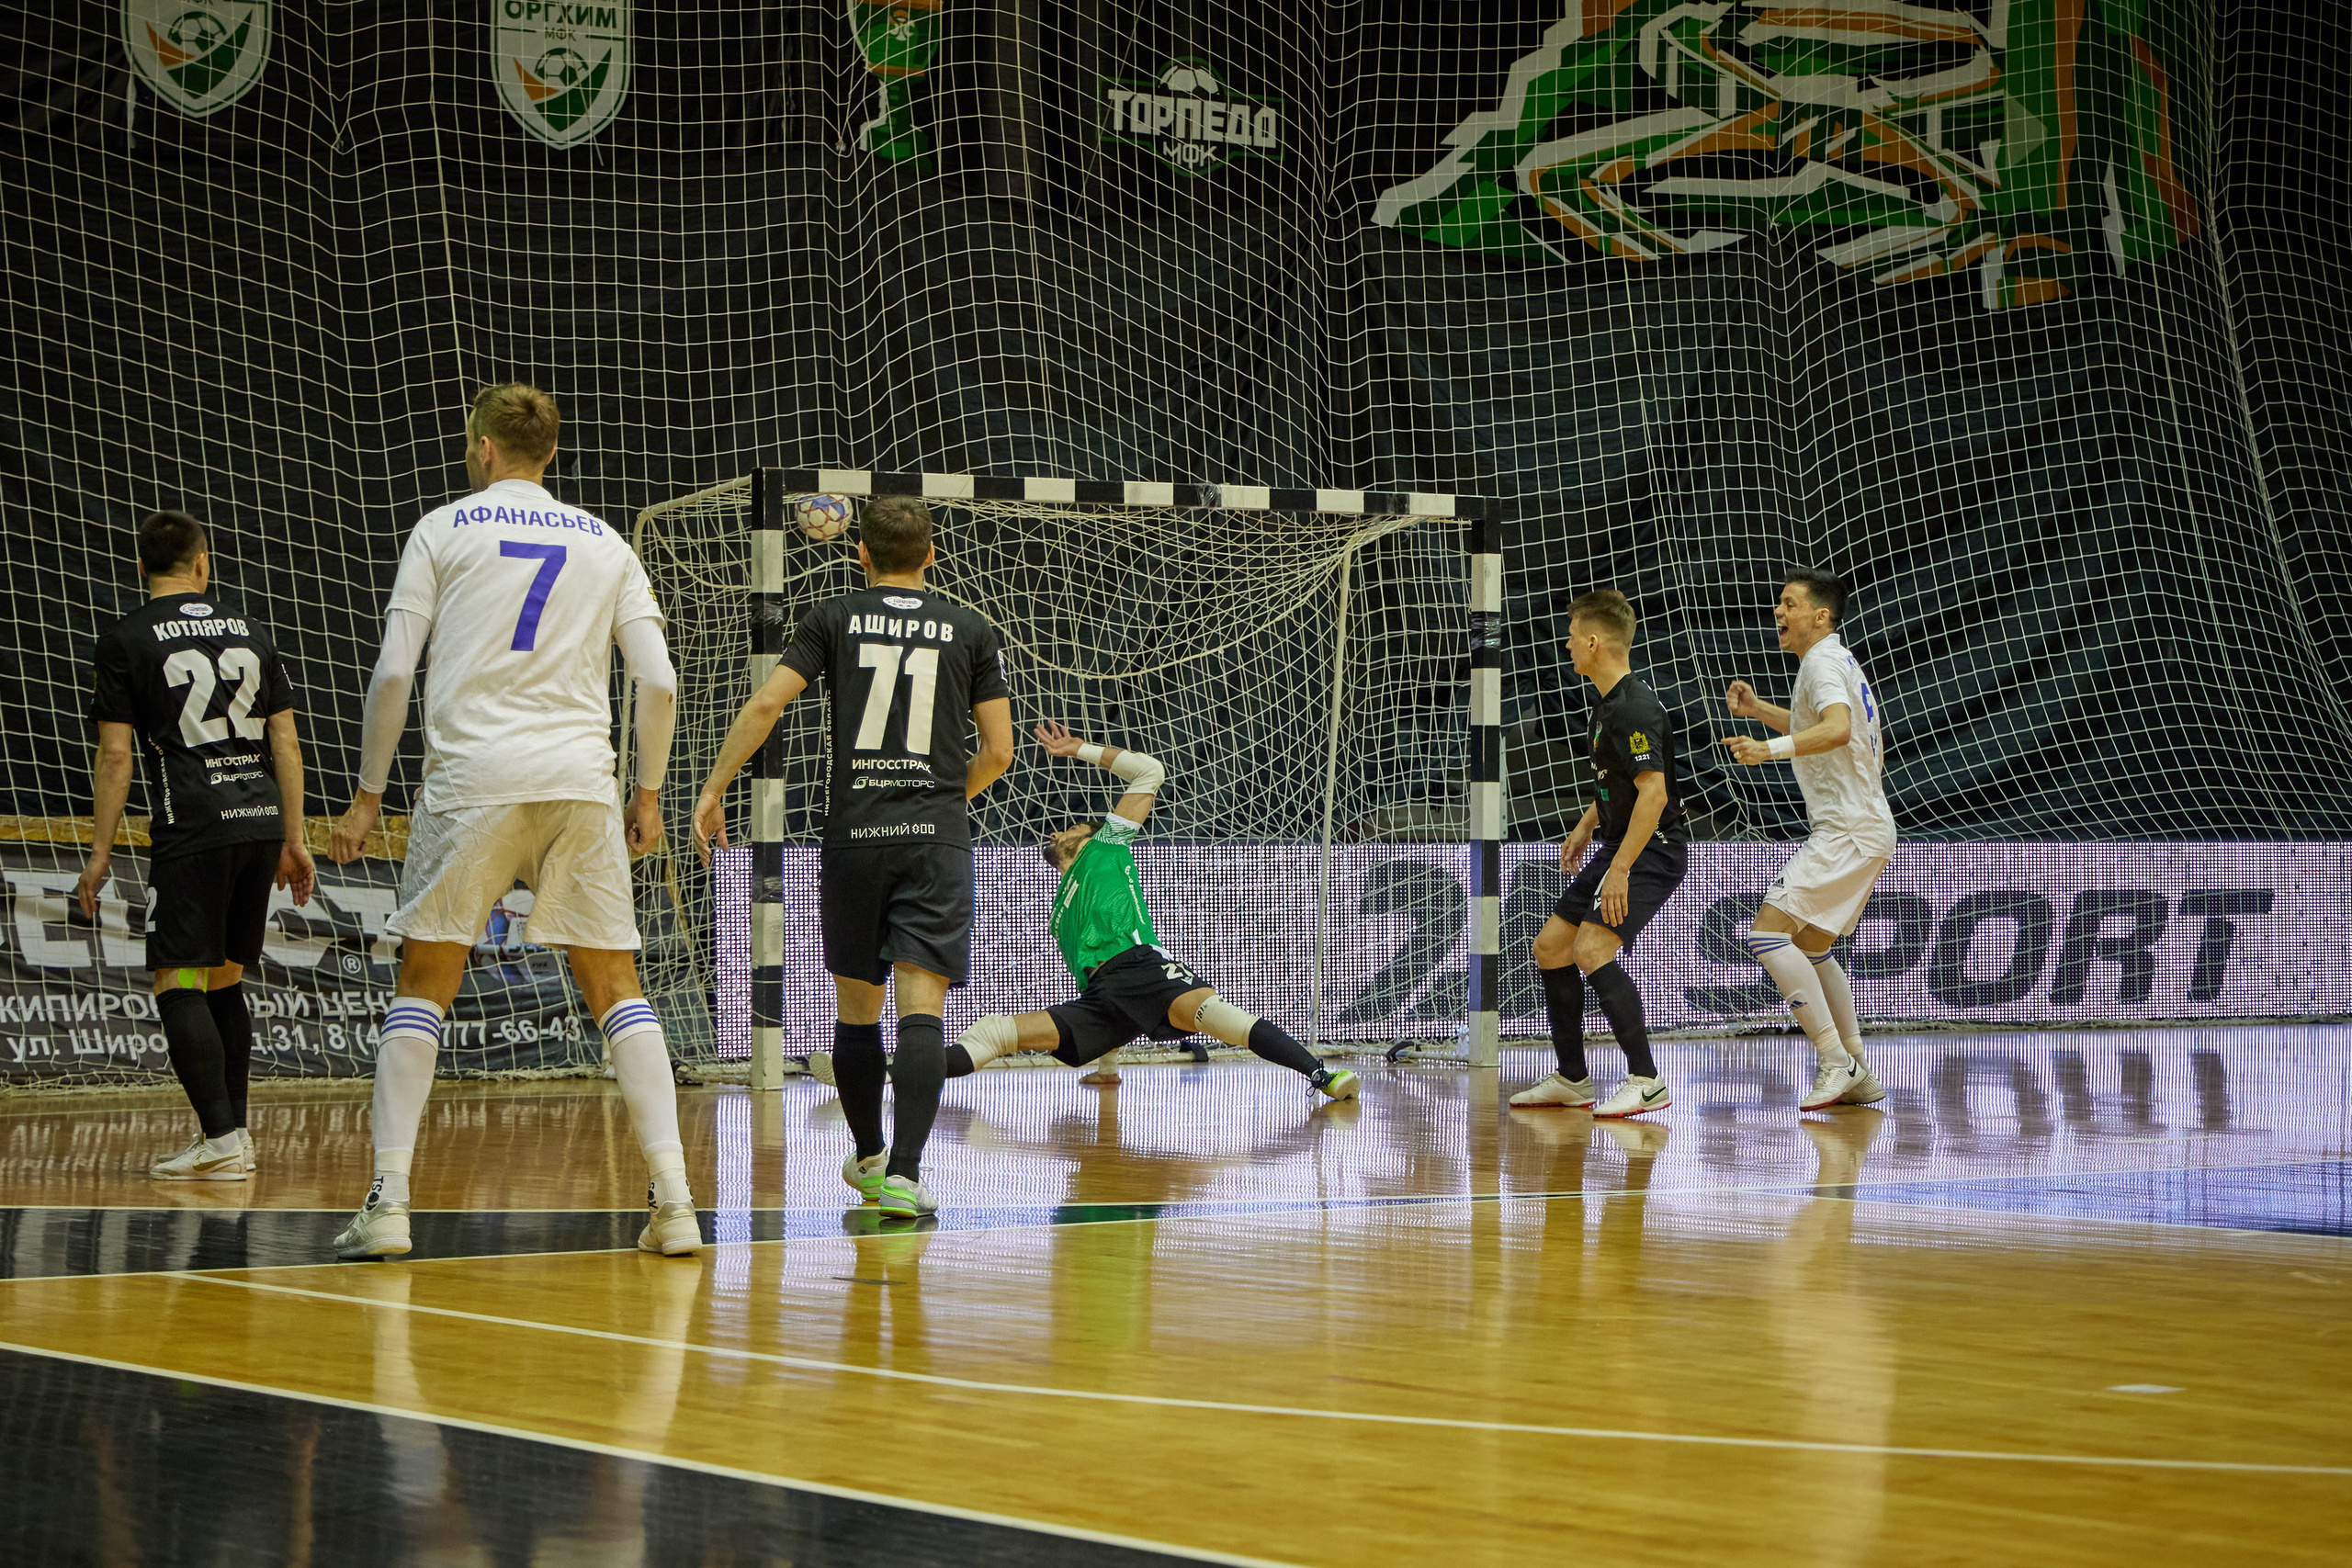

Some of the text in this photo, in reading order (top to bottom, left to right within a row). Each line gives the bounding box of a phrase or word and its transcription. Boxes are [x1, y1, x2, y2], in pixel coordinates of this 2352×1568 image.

[503, 1, 617, 28] ОРГХИМ
[545, 26, 578, 42] МФК
[1107, 88, 1277, 149] ТОРПЕДО
[1162, 141, 1218, 170] МФК
[453, 506, 604, 536] АФАНАСЬЕВ
[499, 539, 567, 652] 7
[152, 617, 250, 642] КОТЛЯРОВ
[847, 614, 955, 643] АШИРОВ
[163, 647, 266, 749] 22
[854, 643, 940, 756] 71
[852, 759, 933, 774] ИНГОССТРАХ
[1634, 753, 1650, 761] 1221
[220, 805, 265, 820] НИЖНИЙ
[851, 822, 910, 840] НИЖНИЙ
[1683, 888, 2275, 1012] SPORT
[6, 1033, 60, 1063] ул.
[327, 1023, 346, 1051] 8
